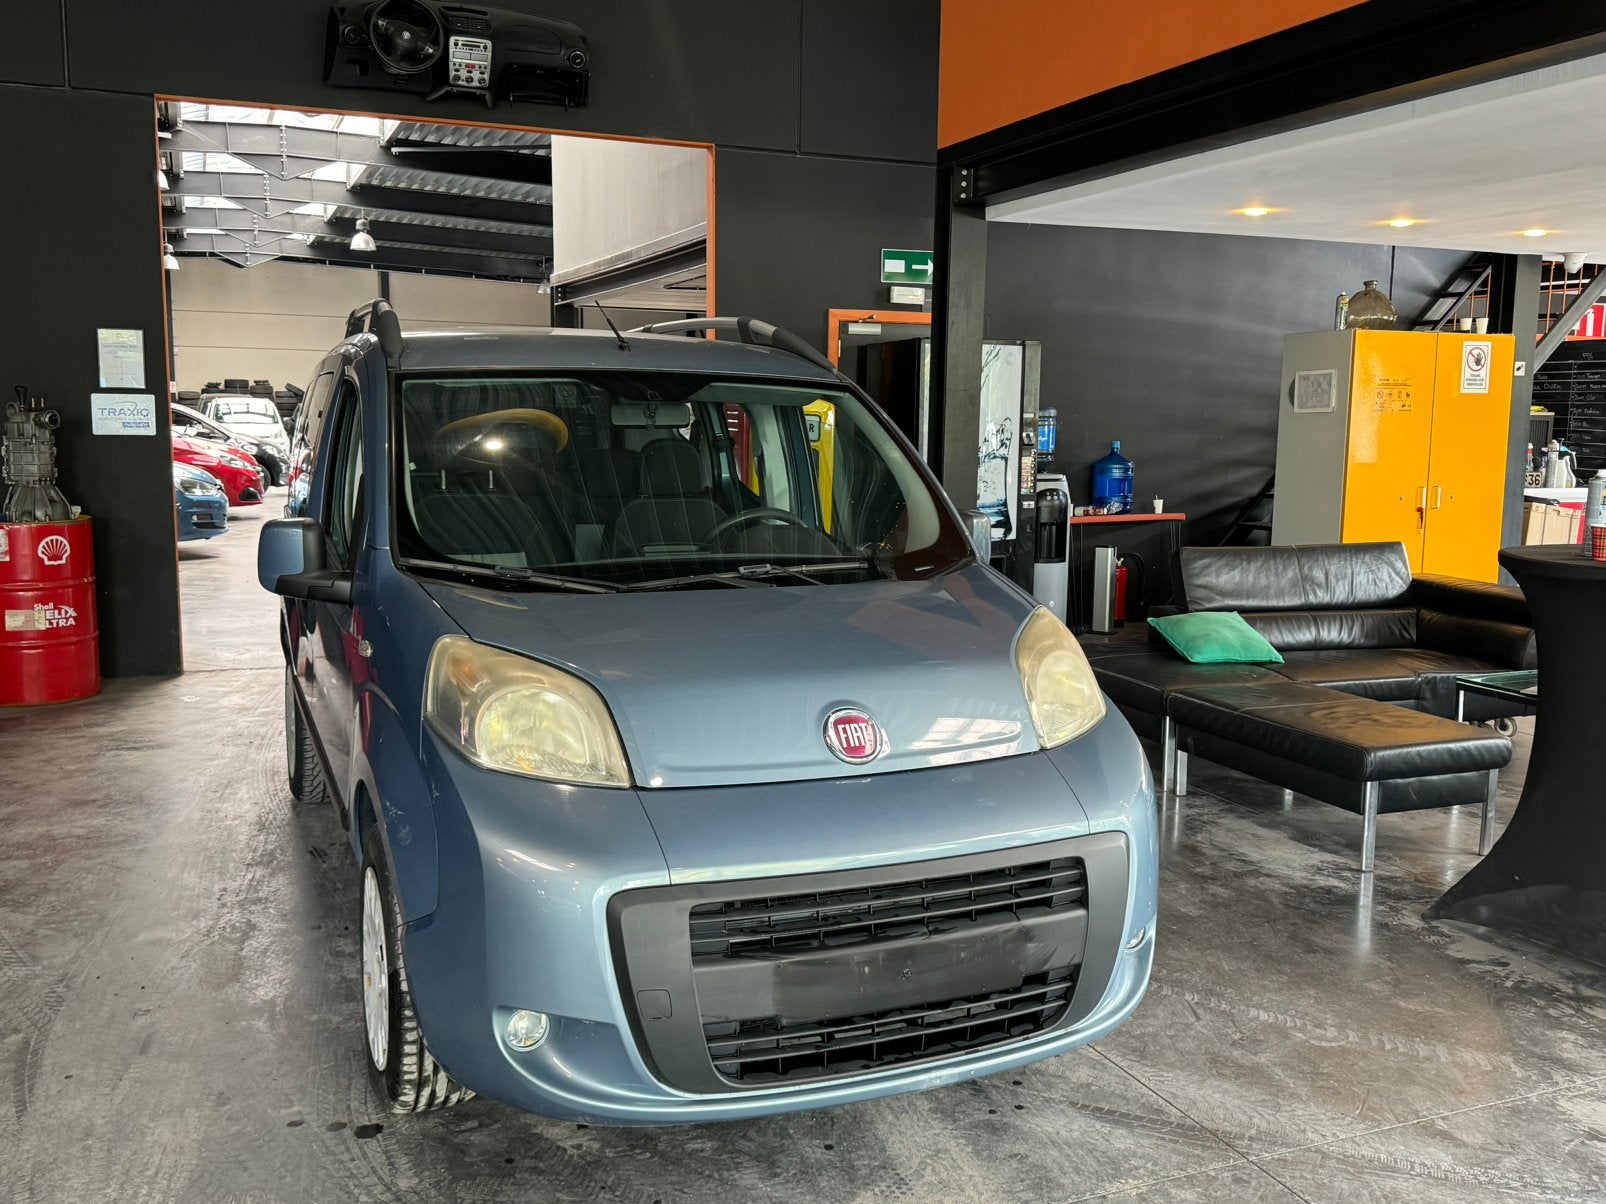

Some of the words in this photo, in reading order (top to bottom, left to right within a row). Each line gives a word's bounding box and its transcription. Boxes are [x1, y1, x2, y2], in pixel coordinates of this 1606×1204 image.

[1525, 473, 1541, 486] 36
[33, 602, 54, 610] Shell
[34, 618, 76, 629] LTRA
[837, 722, 869, 748] FIAT
